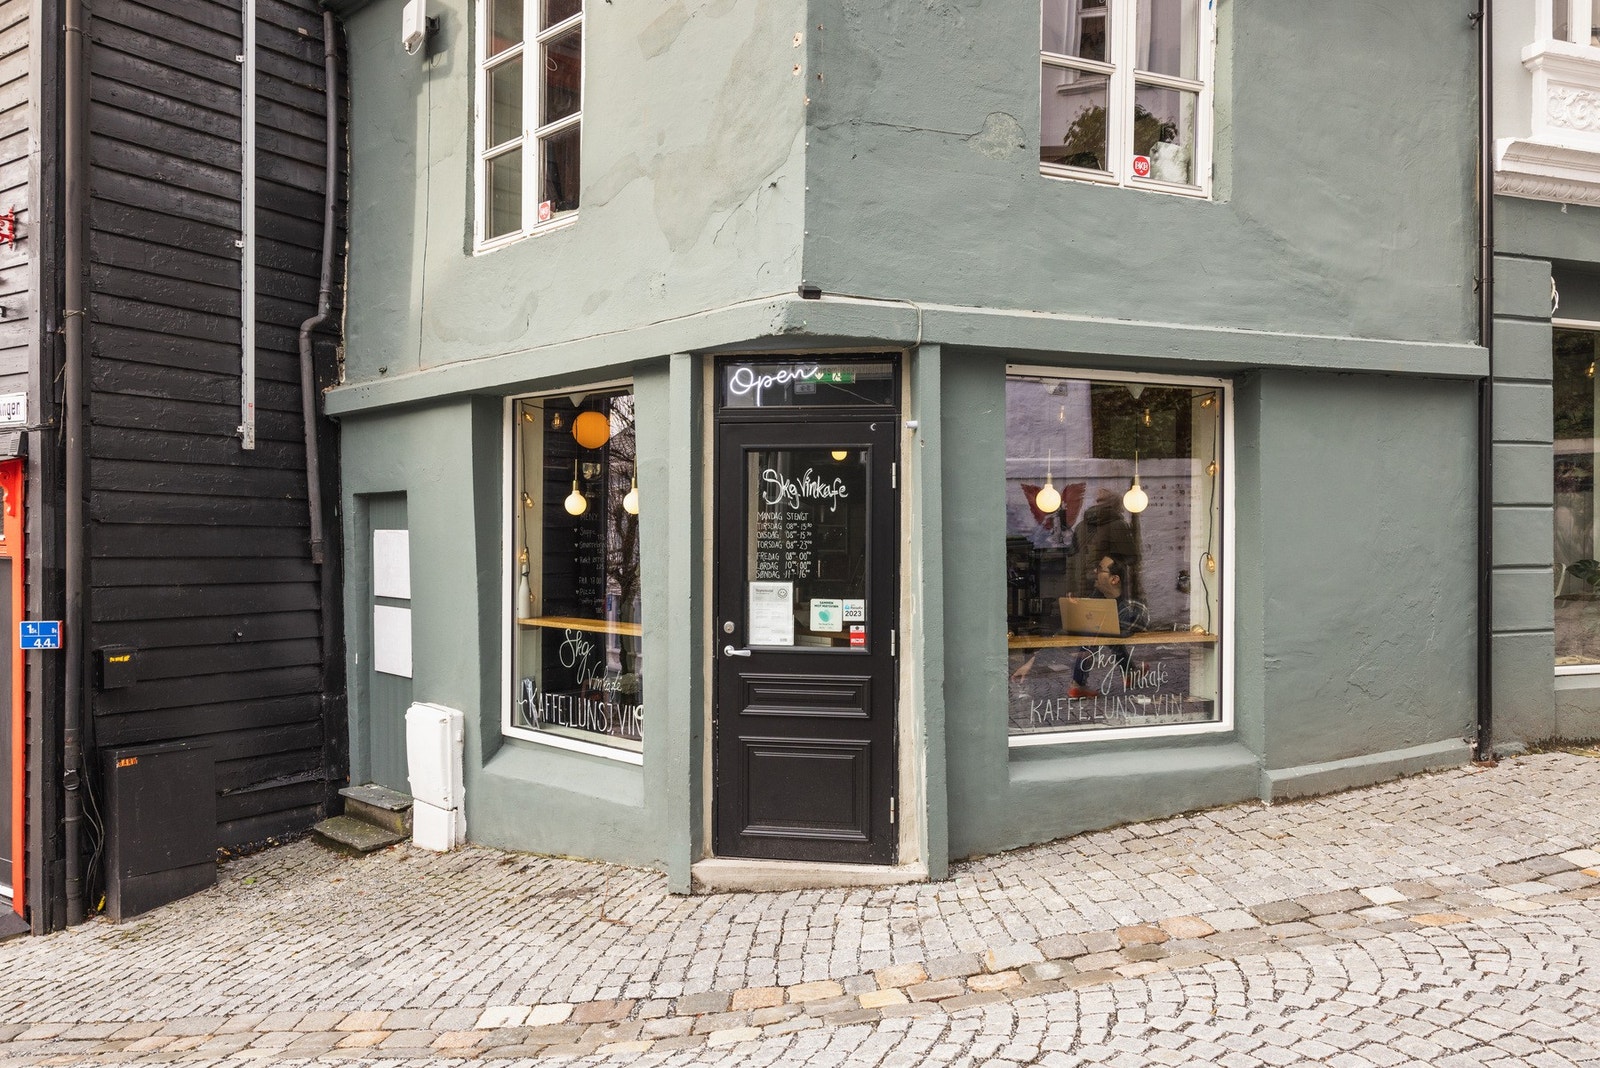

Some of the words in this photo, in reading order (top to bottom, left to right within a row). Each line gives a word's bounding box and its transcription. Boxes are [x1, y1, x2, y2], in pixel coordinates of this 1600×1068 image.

[730, 366, 819, 407] Open
[756, 511, 783, 521] MANDAG
[786, 511, 809, 521] STENGT
[756, 522, 783, 531] TIRSDAG
[756, 530, 780, 539] ONSDAG
[756, 540, 783, 549] TORSDAG
[756, 551, 780, 561] FREDAG
[756, 561, 779, 570] LØRDAG
[755, 570, 780, 579] SØNDAG
[1119, 646, 1168, 693] Vinkafé
[1152, 692, 1183, 717] VIN
